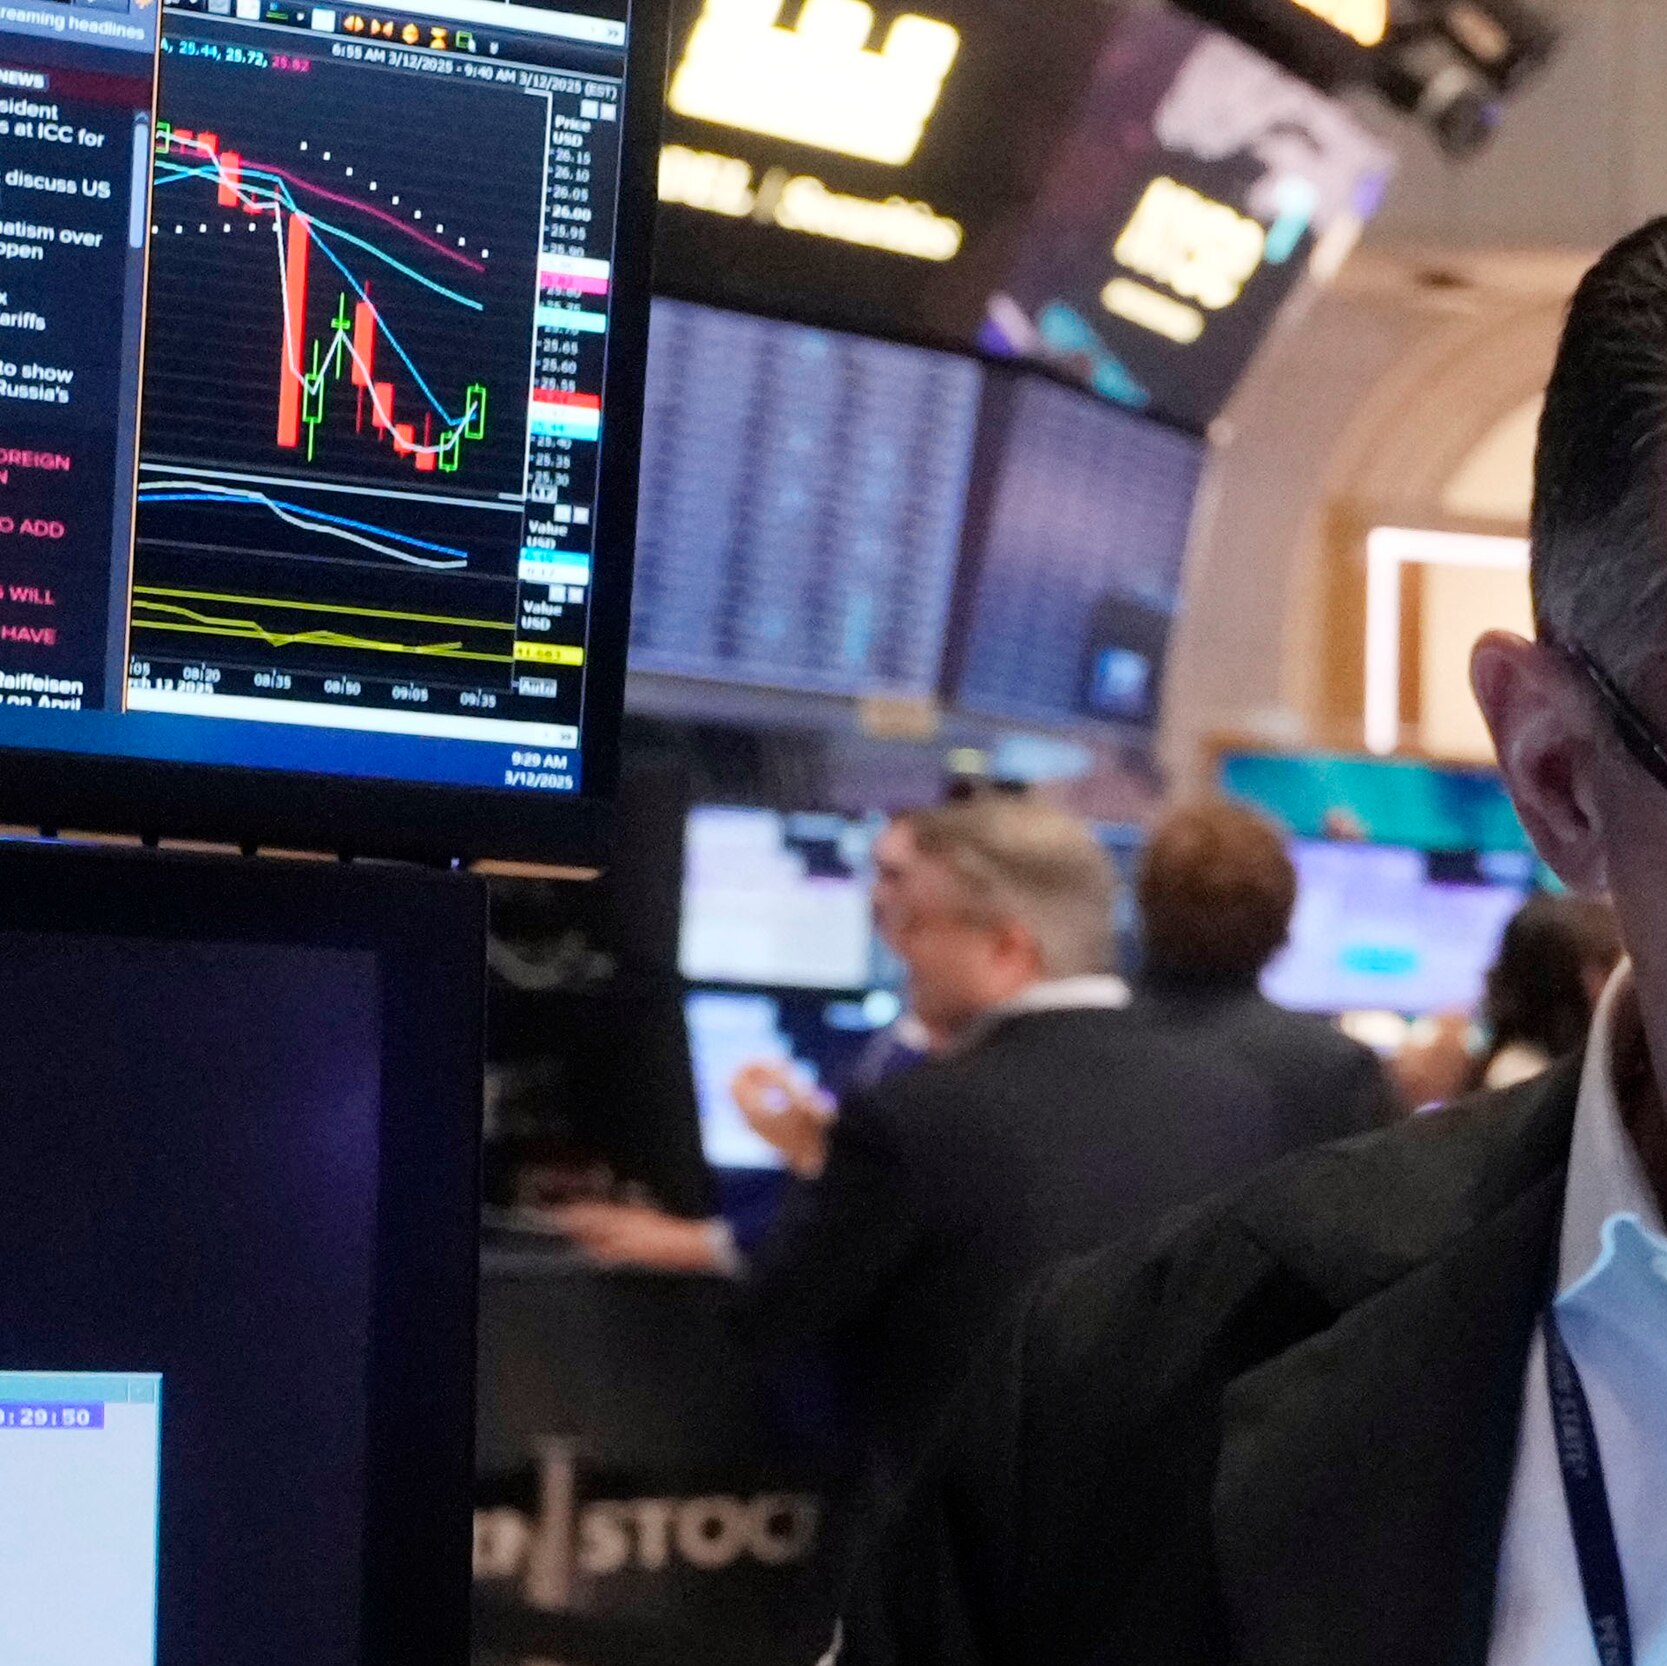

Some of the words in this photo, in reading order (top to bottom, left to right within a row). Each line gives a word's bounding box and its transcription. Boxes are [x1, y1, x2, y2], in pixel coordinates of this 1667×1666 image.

[69, 16, 145, 40] headlines
[364, 50, 385, 63] AM
[496, 70, 516, 85] AM
[518, 74, 582, 93] 3/12/2025
[14, 122, 33, 138] at
[38, 123, 73, 143] ICC
[78, 128, 105, 148] for
[552, 131, 583, 148] USD
[5, 169, 77, 194] discuss
[81, 178, 111, 199] US
[0, 221, 54, 241] atism
[59, 229, 103, 247] over
[21, 362, 73, 384] show
[20, 518, 65, 539] ADD
[9, 585, 55, 606] WILL
[543, 754, 568, 770] AM
[505, 770, 573, 790] 3/12/2025
